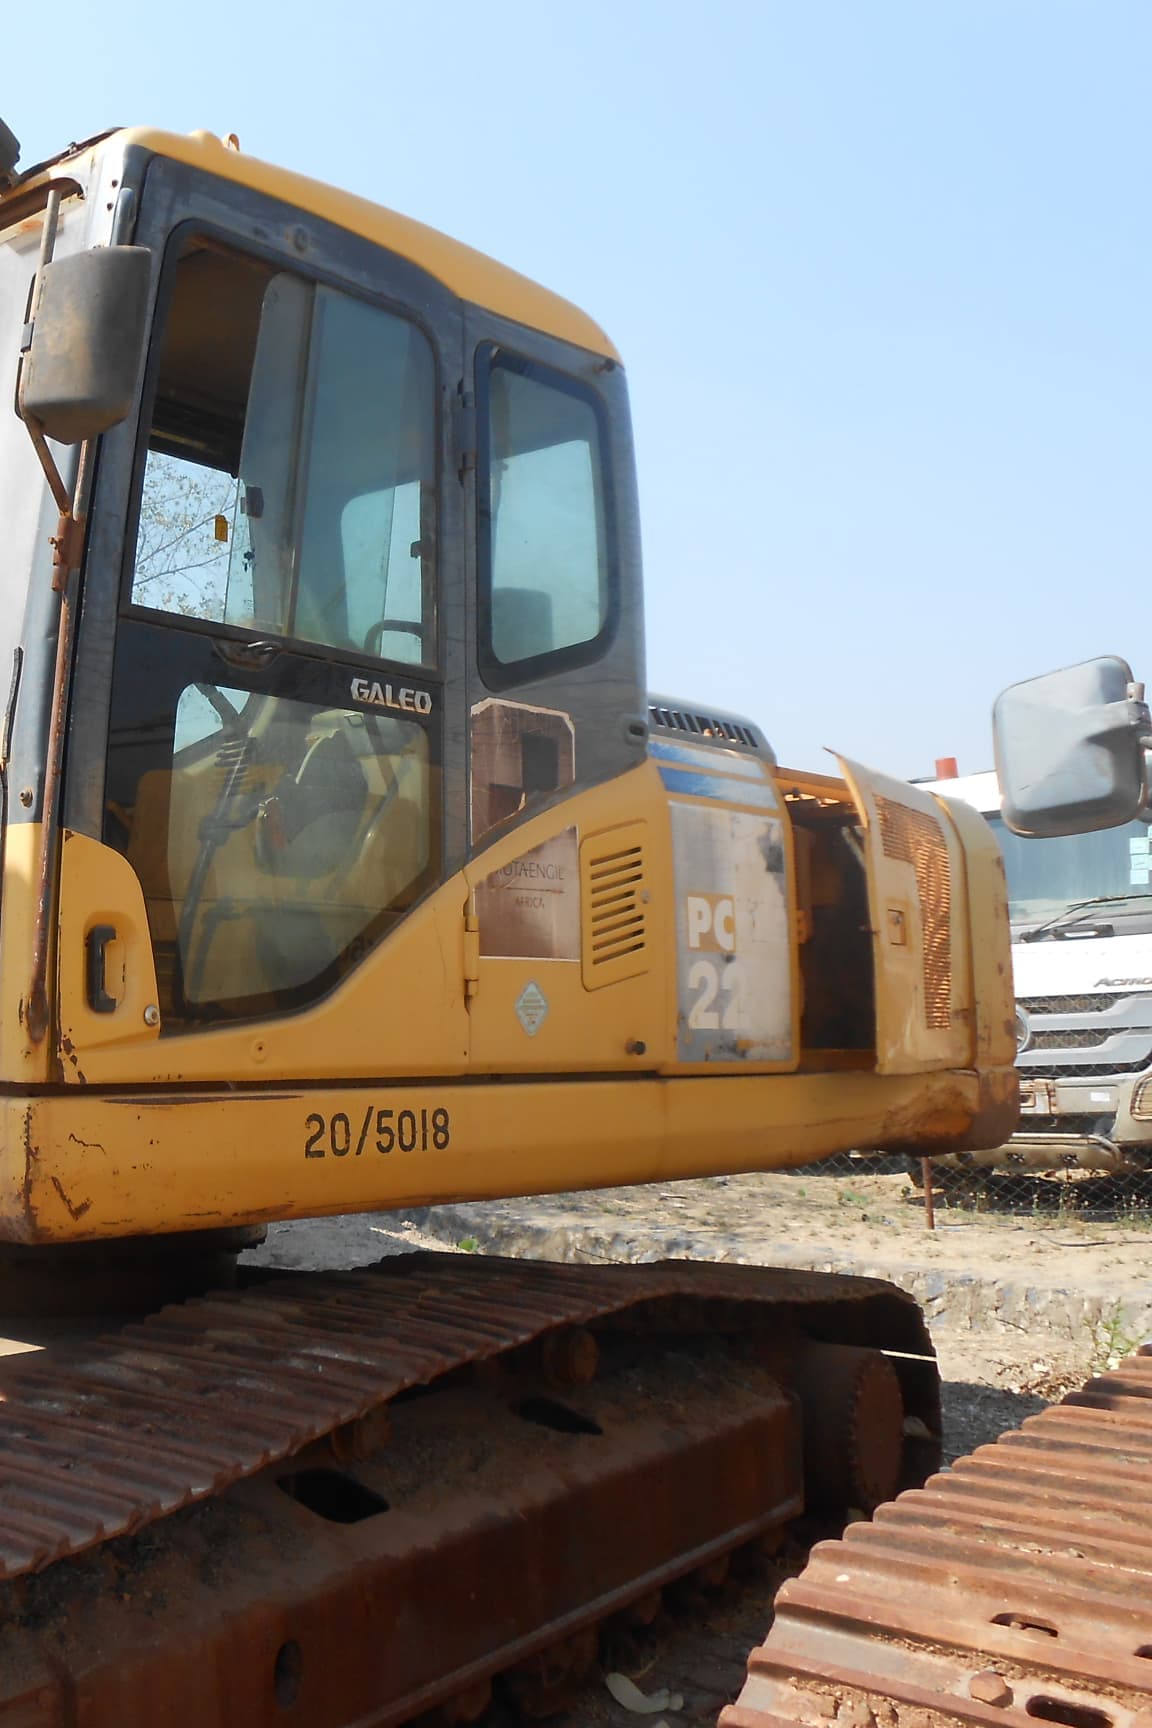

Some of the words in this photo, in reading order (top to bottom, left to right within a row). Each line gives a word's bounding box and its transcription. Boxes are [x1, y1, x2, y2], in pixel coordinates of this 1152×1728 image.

[350, 678, 433, 715] GALEO
[687, 896, 734, 950] PC
[305, 1106, 450, 1158] 20/5018
